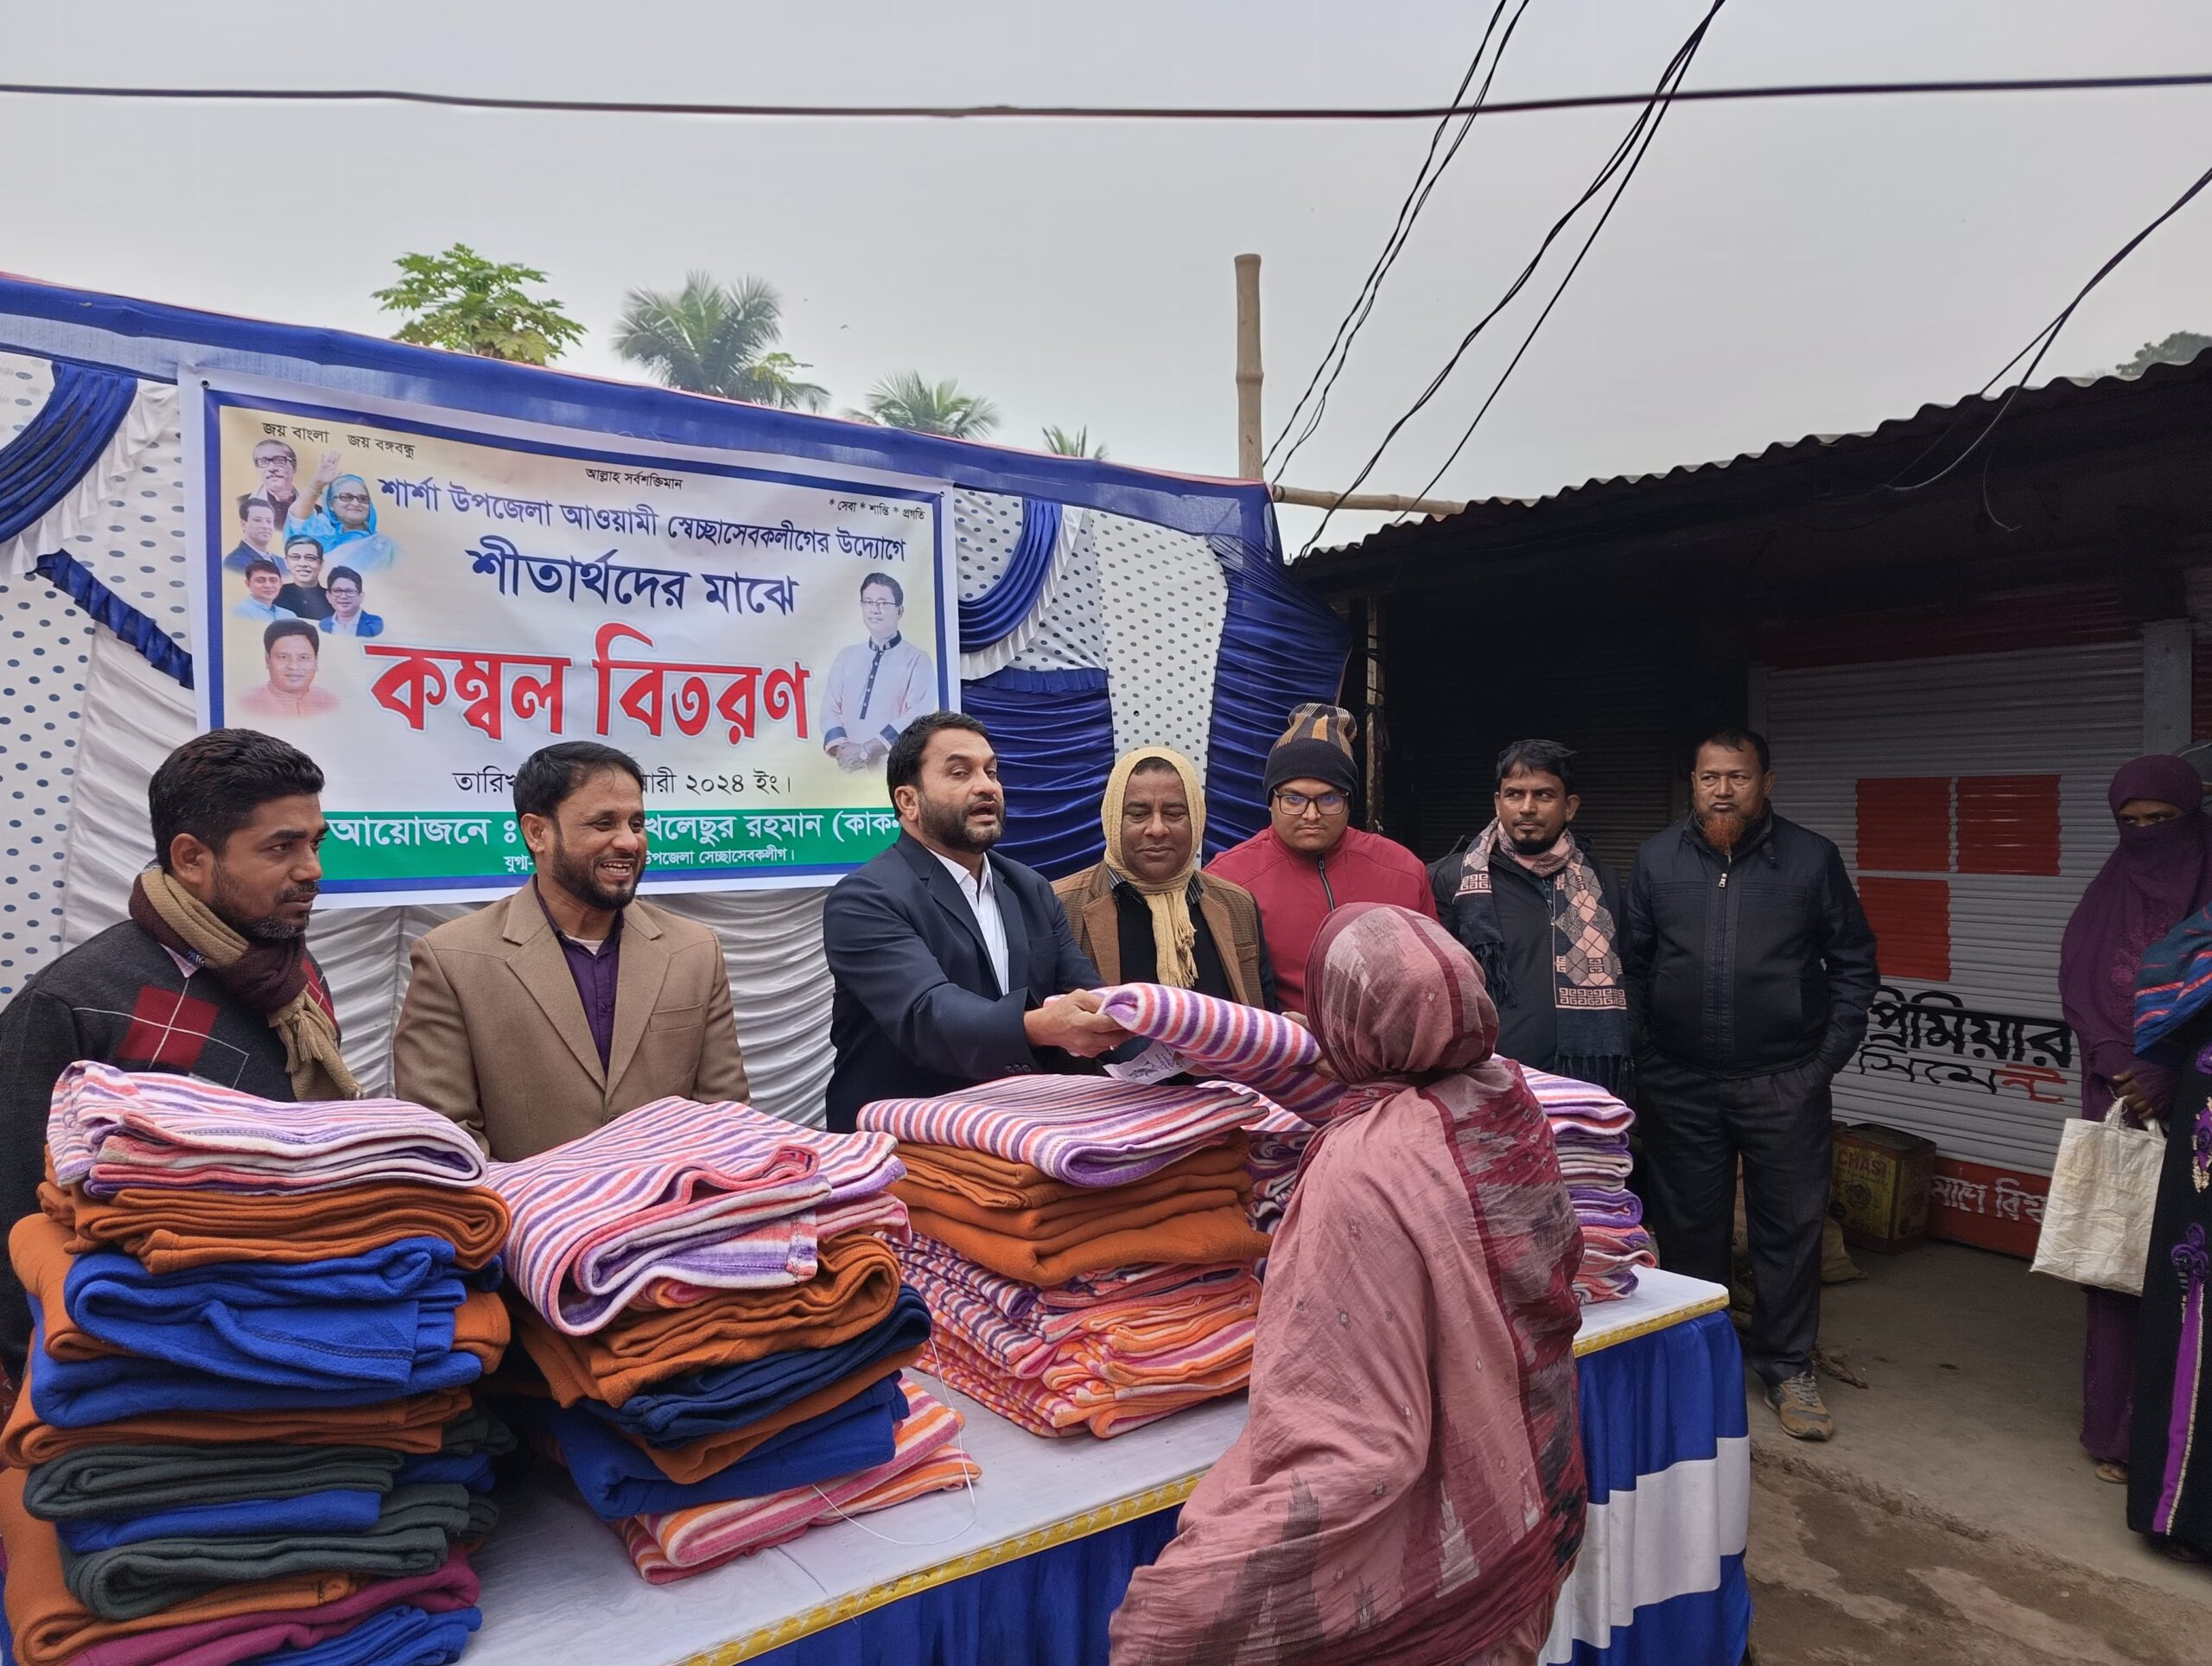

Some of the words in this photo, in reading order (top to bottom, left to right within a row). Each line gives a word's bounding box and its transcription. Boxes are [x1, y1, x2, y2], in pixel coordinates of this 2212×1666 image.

[261, 422, 287, 438] জয়
[291, 426, 330, 443] বাংলা
[347, 434, 371, 449] জয়
[375, 438, 416, 461] বঙ্গবন্ধু
[586, 468, 621, 485] আল্লাহ
[624, 471, 683, 490] সর্বশক্তিমান
[378, 477, 442, 512] শার্শা
[448, 481, 553, 525] উপজেলা
[559, 504, 659, 537] আওয়ামী
[668, 516, 830, 554] স্বেচ্ছাসেবকলীগের
[836, 526, 906, 562] উদ্যোগে
[837, 500, 857, 513] সেবা
[868, 502, 890, 516] শান্তি
[902, 506, 925, 519] প্রগতি
[465, 535, 691, 610] শীতার্থদের
[701, 570, 800, 616] মাঝে
[364, 645, 572, 741] কম্বল
[592, 622, 811, 746] বিতরণ
[686, 773, 744, 795] ২০২৪
[325, 815, 493, 847] আয়োজনে
[644, 813, 737, 847] খলেছুর
[743, 812, 824, 840] রহমান
